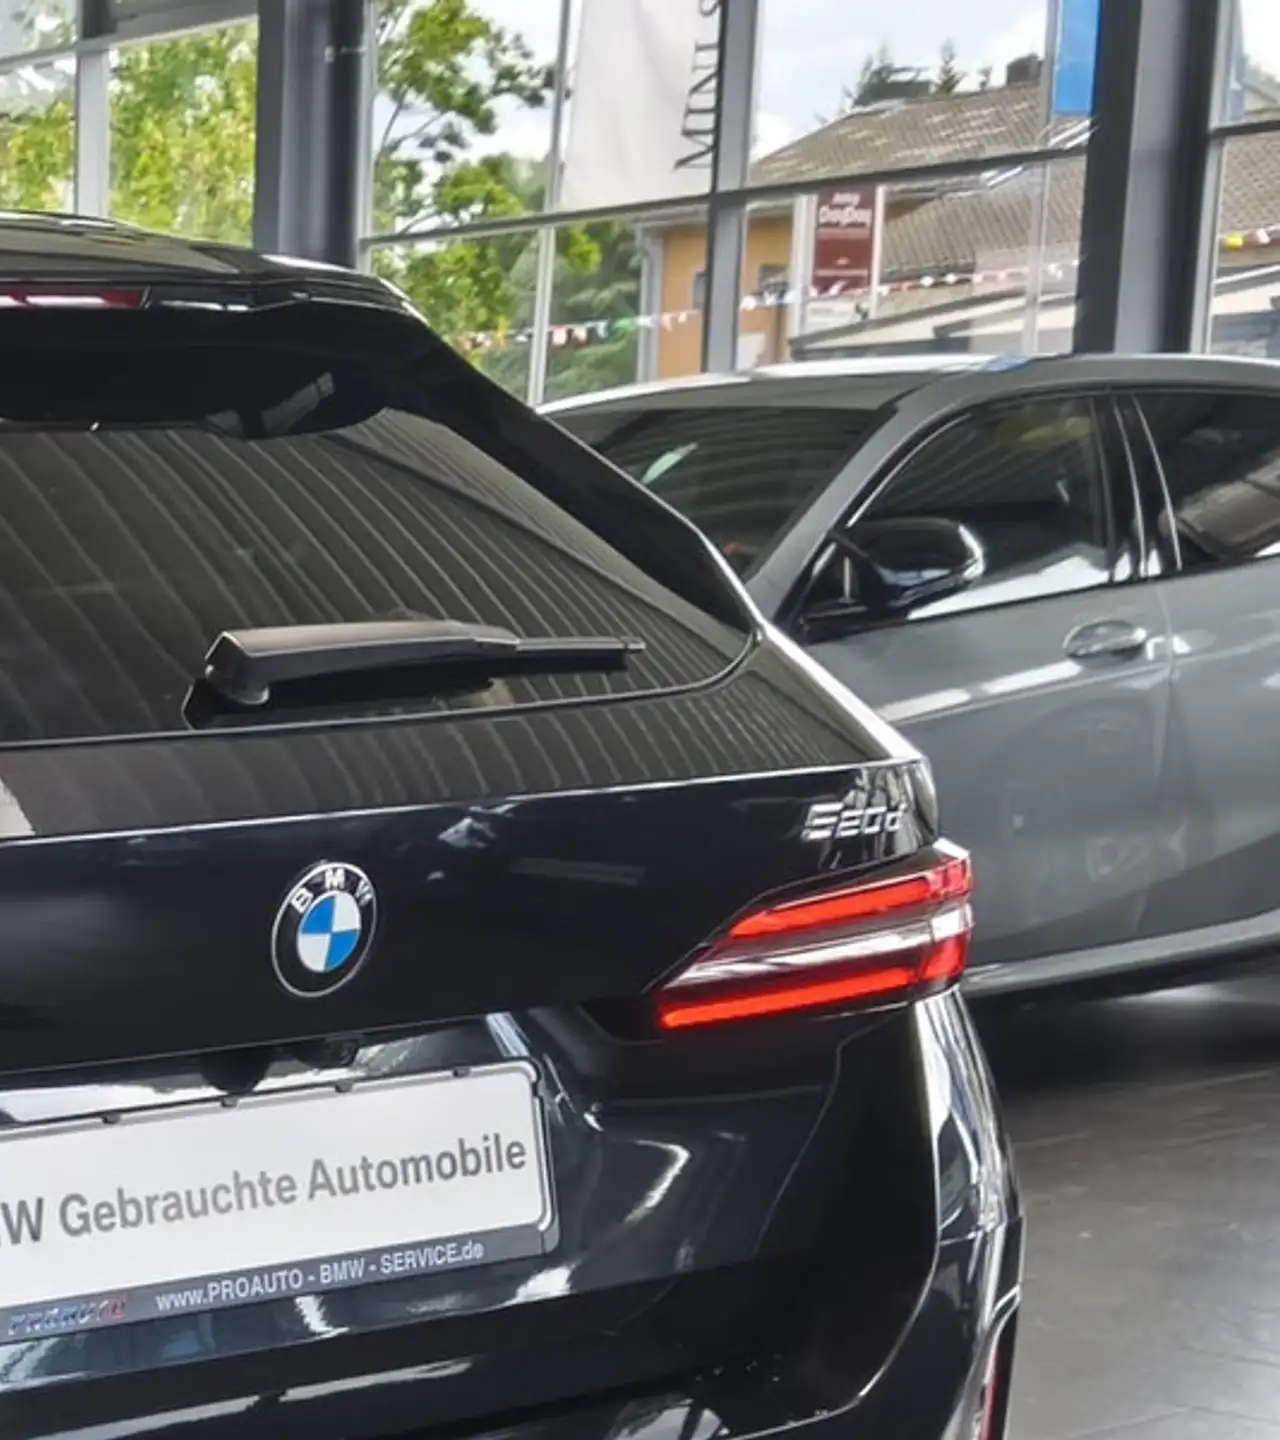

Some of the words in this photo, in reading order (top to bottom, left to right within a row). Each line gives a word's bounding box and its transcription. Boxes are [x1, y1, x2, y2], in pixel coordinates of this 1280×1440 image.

[291, 868, 373, 914] BMW
[58, 1170, 298, 1238] Gebrauchte
[307, 1134, 528, 1198] Automobile
[319, 1258, 365, 1285] BMW
[380, 1241, 485, 1274] SERVICE.de
